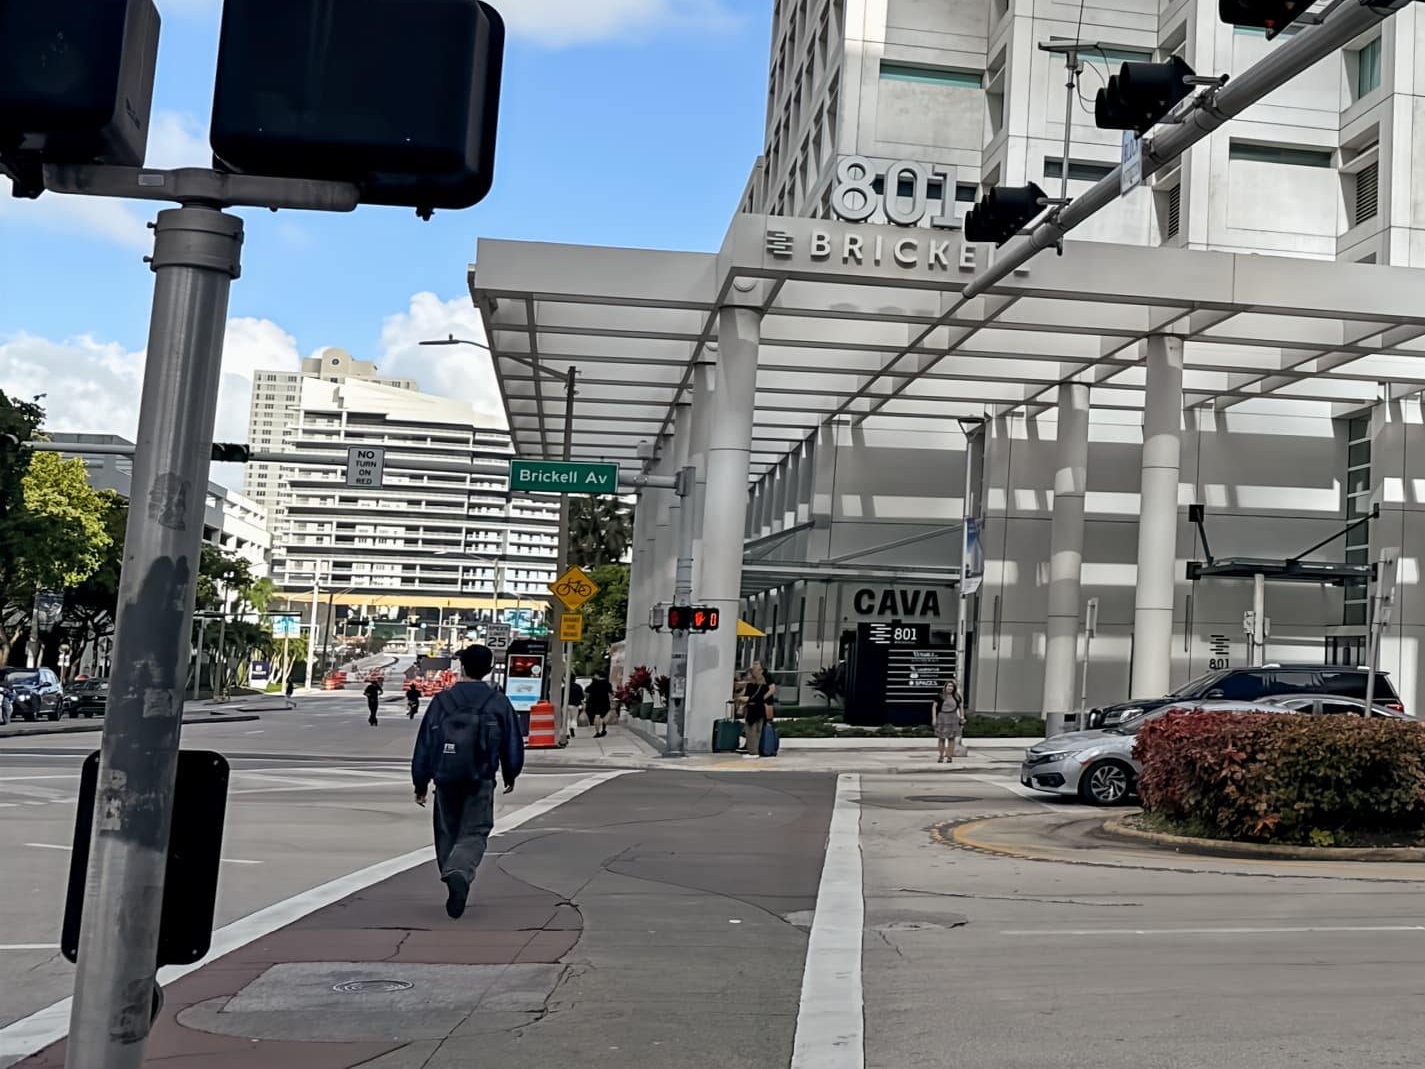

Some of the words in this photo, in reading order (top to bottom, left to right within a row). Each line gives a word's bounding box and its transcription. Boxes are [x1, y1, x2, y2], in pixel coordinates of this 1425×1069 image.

[831, 156, 964, 229] 801
[810, 231, 1030, 276] BRICKEL
[357, 450, 375, 459] NO
[356, 460, 377, 468] TURN
[520, 469, 577, 484] Brickell
[584, 471, 607, 484] Av
[853, 588, 940, 616] CAVA
[893, 628, 917, 641] 801
[487, 637, 506, 647] 25
[1209, 658, 1229, 670] 801
